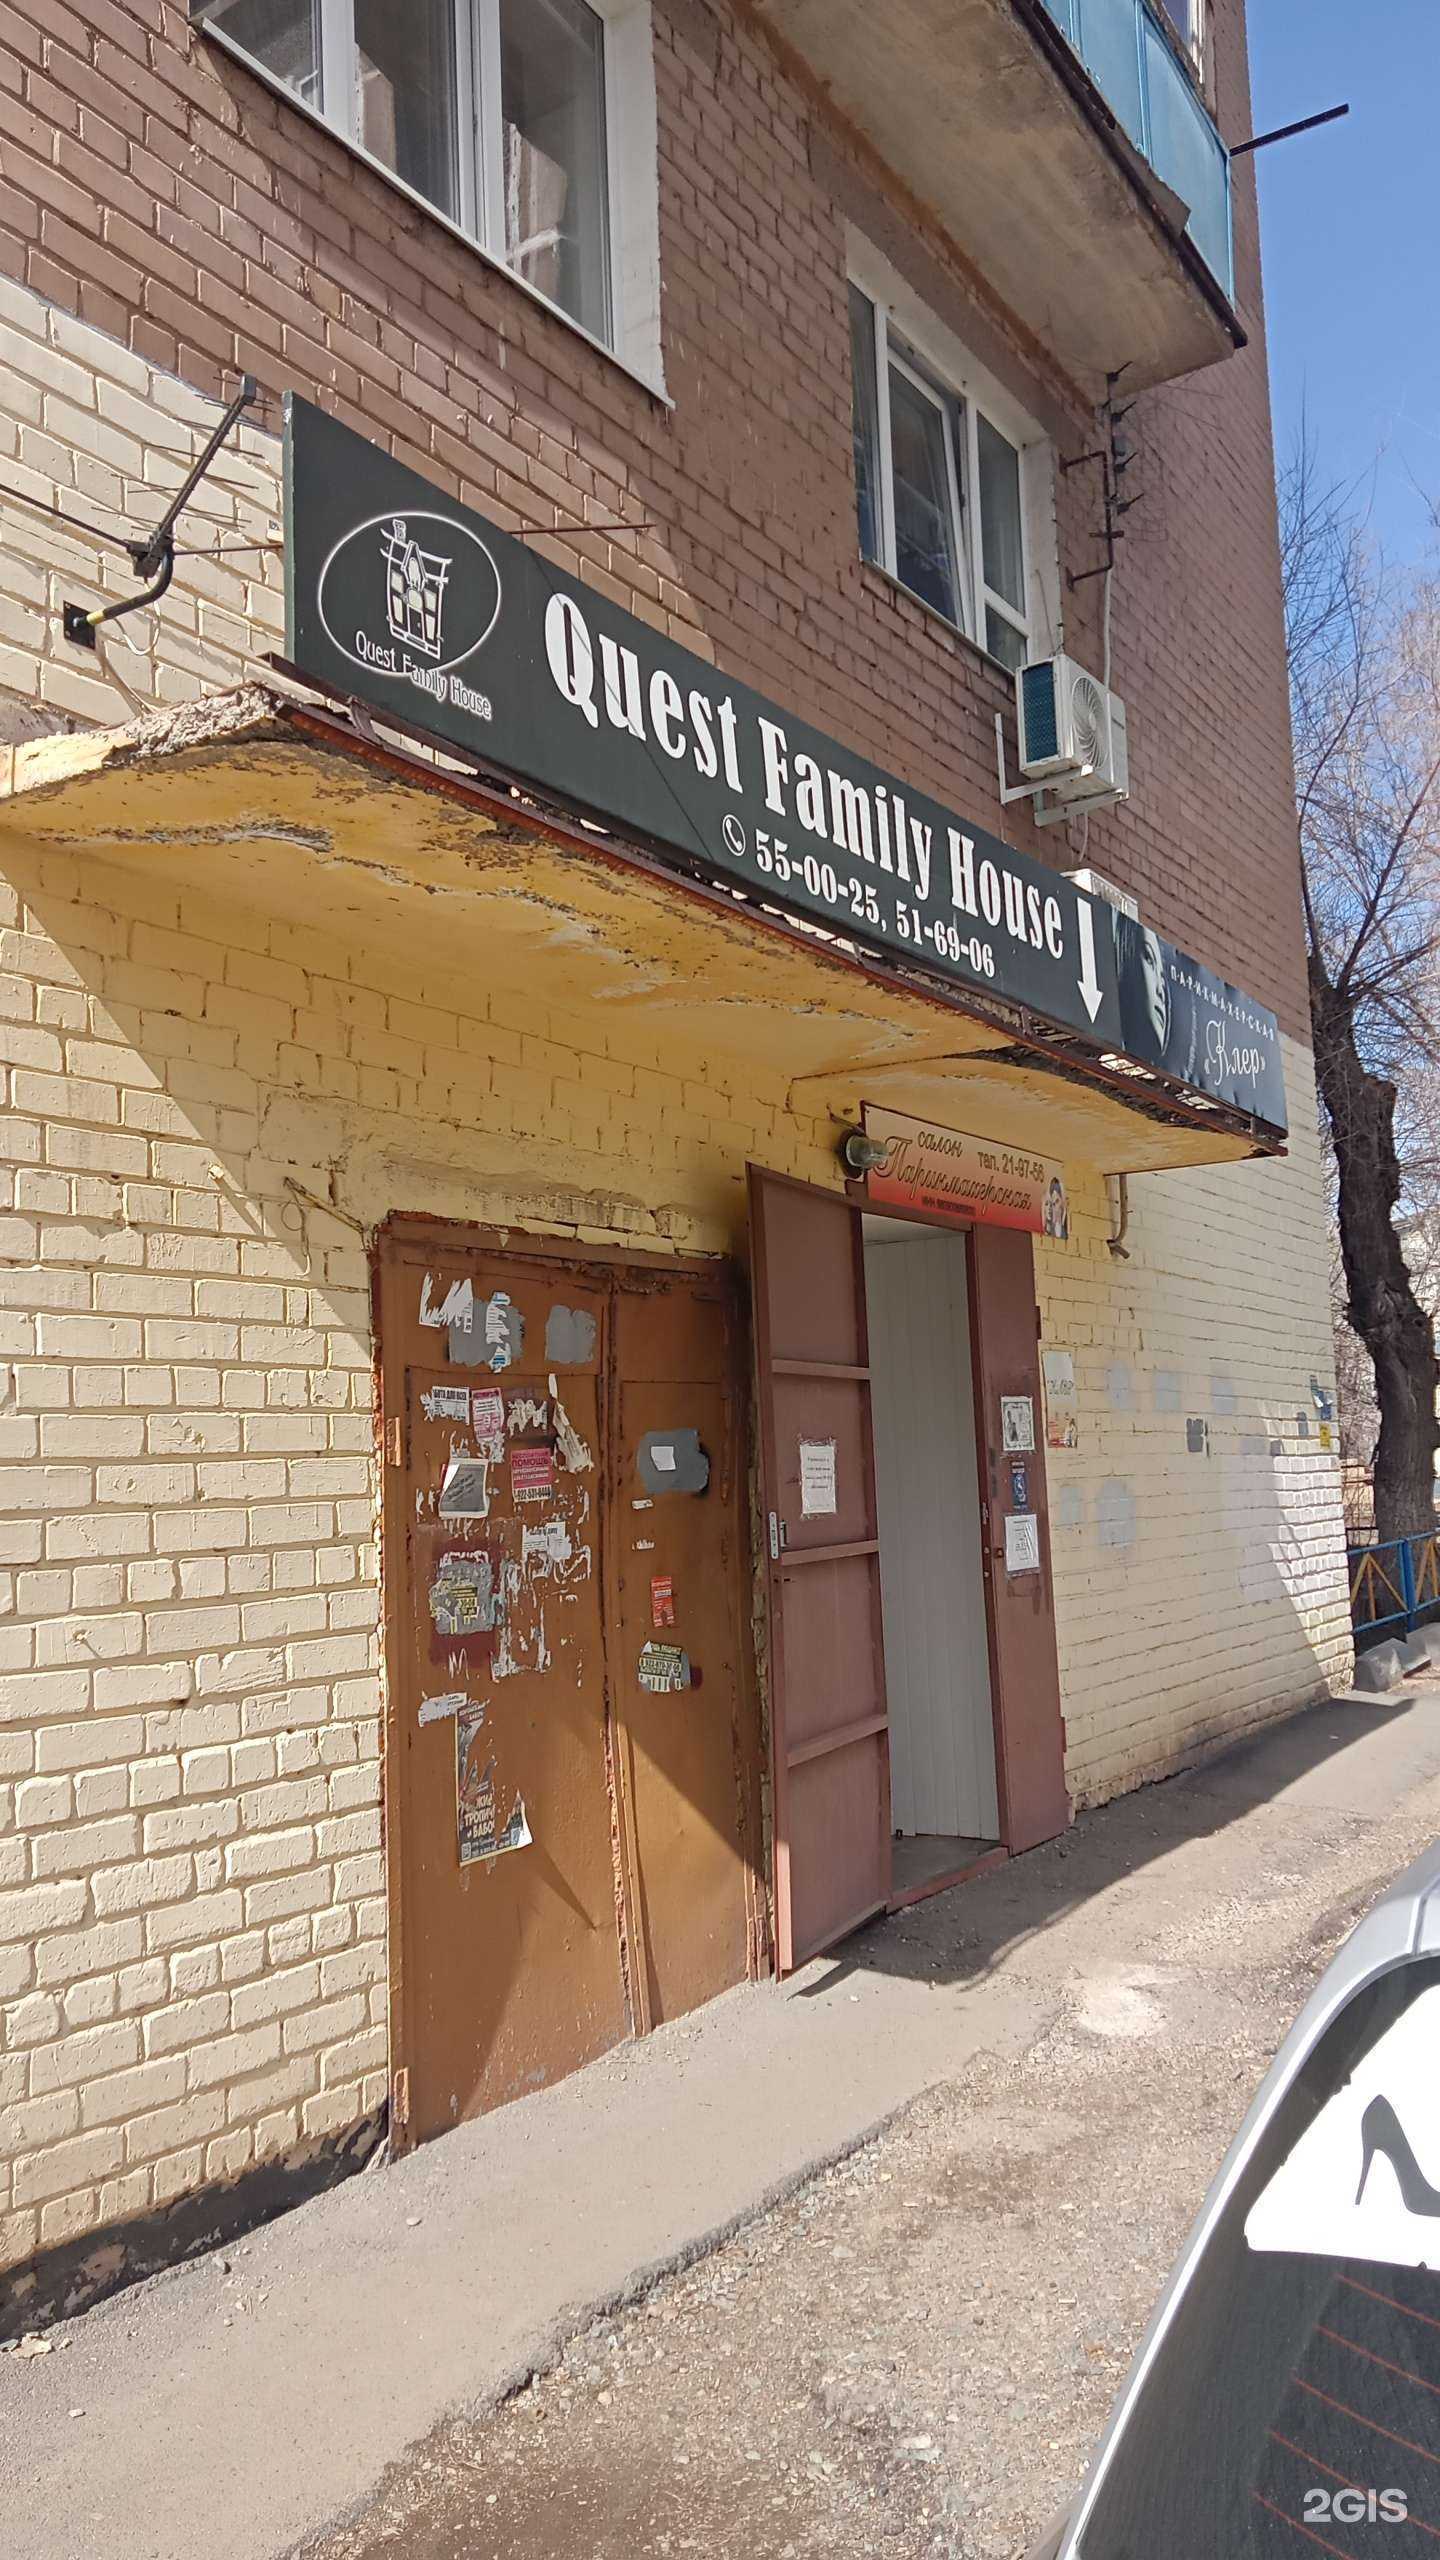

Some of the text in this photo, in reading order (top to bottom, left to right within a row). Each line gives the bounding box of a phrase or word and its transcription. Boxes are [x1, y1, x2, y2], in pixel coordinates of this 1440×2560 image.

[356, 630, 492, 721] Quest Family House
[545, 593, 1063, 959] Quest Family House
[755, 829, 995, 978] 55-00-25, 51-69-06
[917, 1131, 964, 1158] салон
